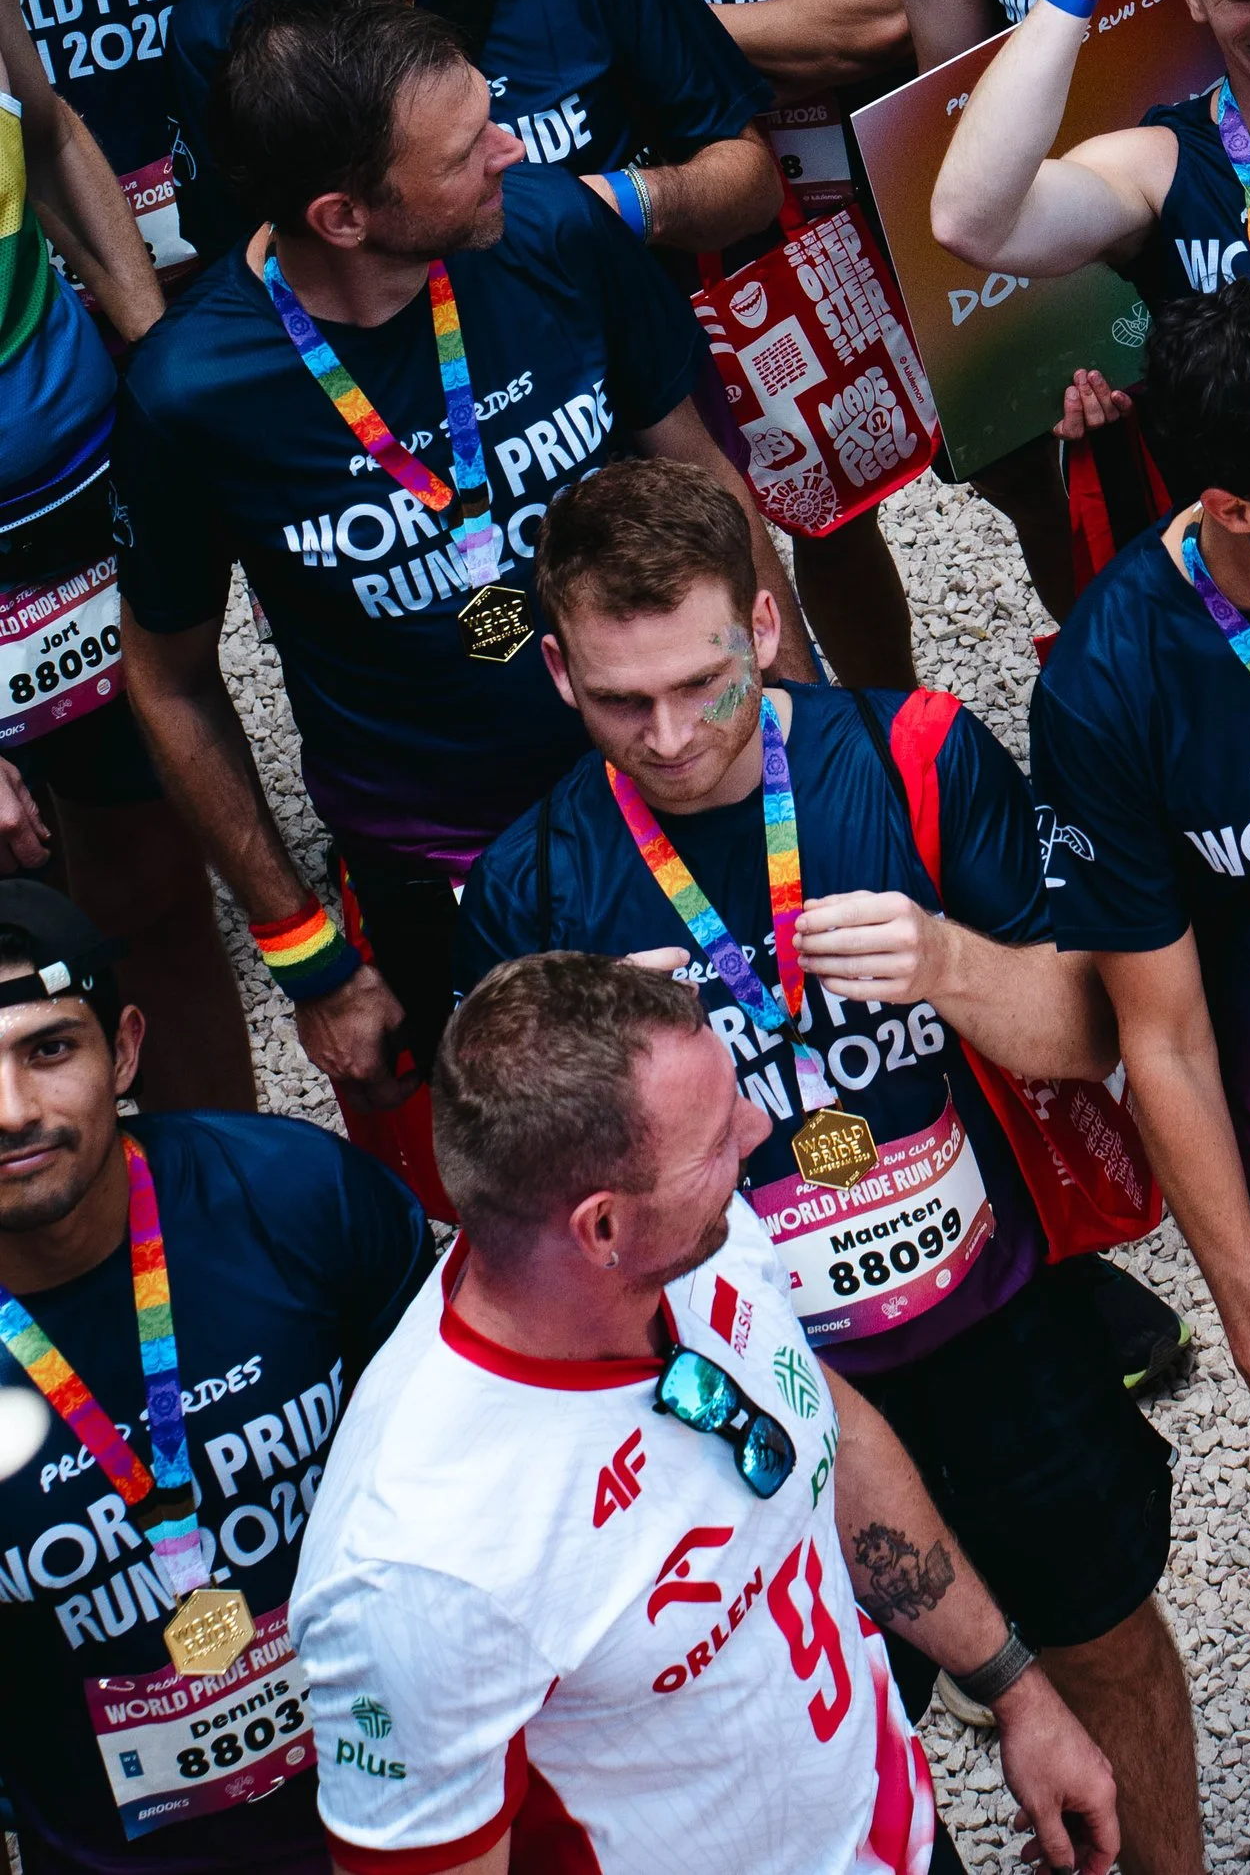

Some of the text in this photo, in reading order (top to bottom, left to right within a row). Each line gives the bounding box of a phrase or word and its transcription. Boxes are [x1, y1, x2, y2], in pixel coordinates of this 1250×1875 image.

[1098, 1, 1136, 34] RUN
[784, 105, 828, 124] 2026
[134, 180, 175, 210] 2026
[901, 363, 925, 405] lululemon
[494, 377, 614, 499] PRIDE
[17, 590, 60, 629] PRIDE
[57, 573, 90, 605] RUN
[87, 555, 118, 587] 202
[351, 542, 470, 620] RUN
[40, 620, 80, 654] Jort
[8, 623, 121, 705] 88090
[797, 1124, 864, 1154] WORLD
[810, 1139, 862, 1167] PRIDE
[884, 1136, 936, 1166] RUN CLUB
[1094, 1127, 1116, 1161] RACE
[760, 1122, 961, 1238] WORLD PRIDE RUN 2026
[1114, 1152, 1132, 1185] THAN
[829, 1197, 943, 1255] Maarten
[828, 1207, 962, 1297] 88099
[733, 1298, 754, 1360] POLSKA
[806, 1318, 852, 1335] BROOKS
[53, 1553, 178, 1651] RUN
[170, 1599, 243, 1644] WORLD
[652, 1566, 765, 1694] ORLEN
[103, 1688, 189, 1726] WORLD
[189, 1658, 250, 1705] PRIDE
[249, 1631, 293, 1674] RUN
[189, 1678, 290, 1740] Dennis
[176, 1688, 310, 1779] 8803
[336, 1735, 407, 1782] plus
[138, 1797, 190, 1821] BROOKS
